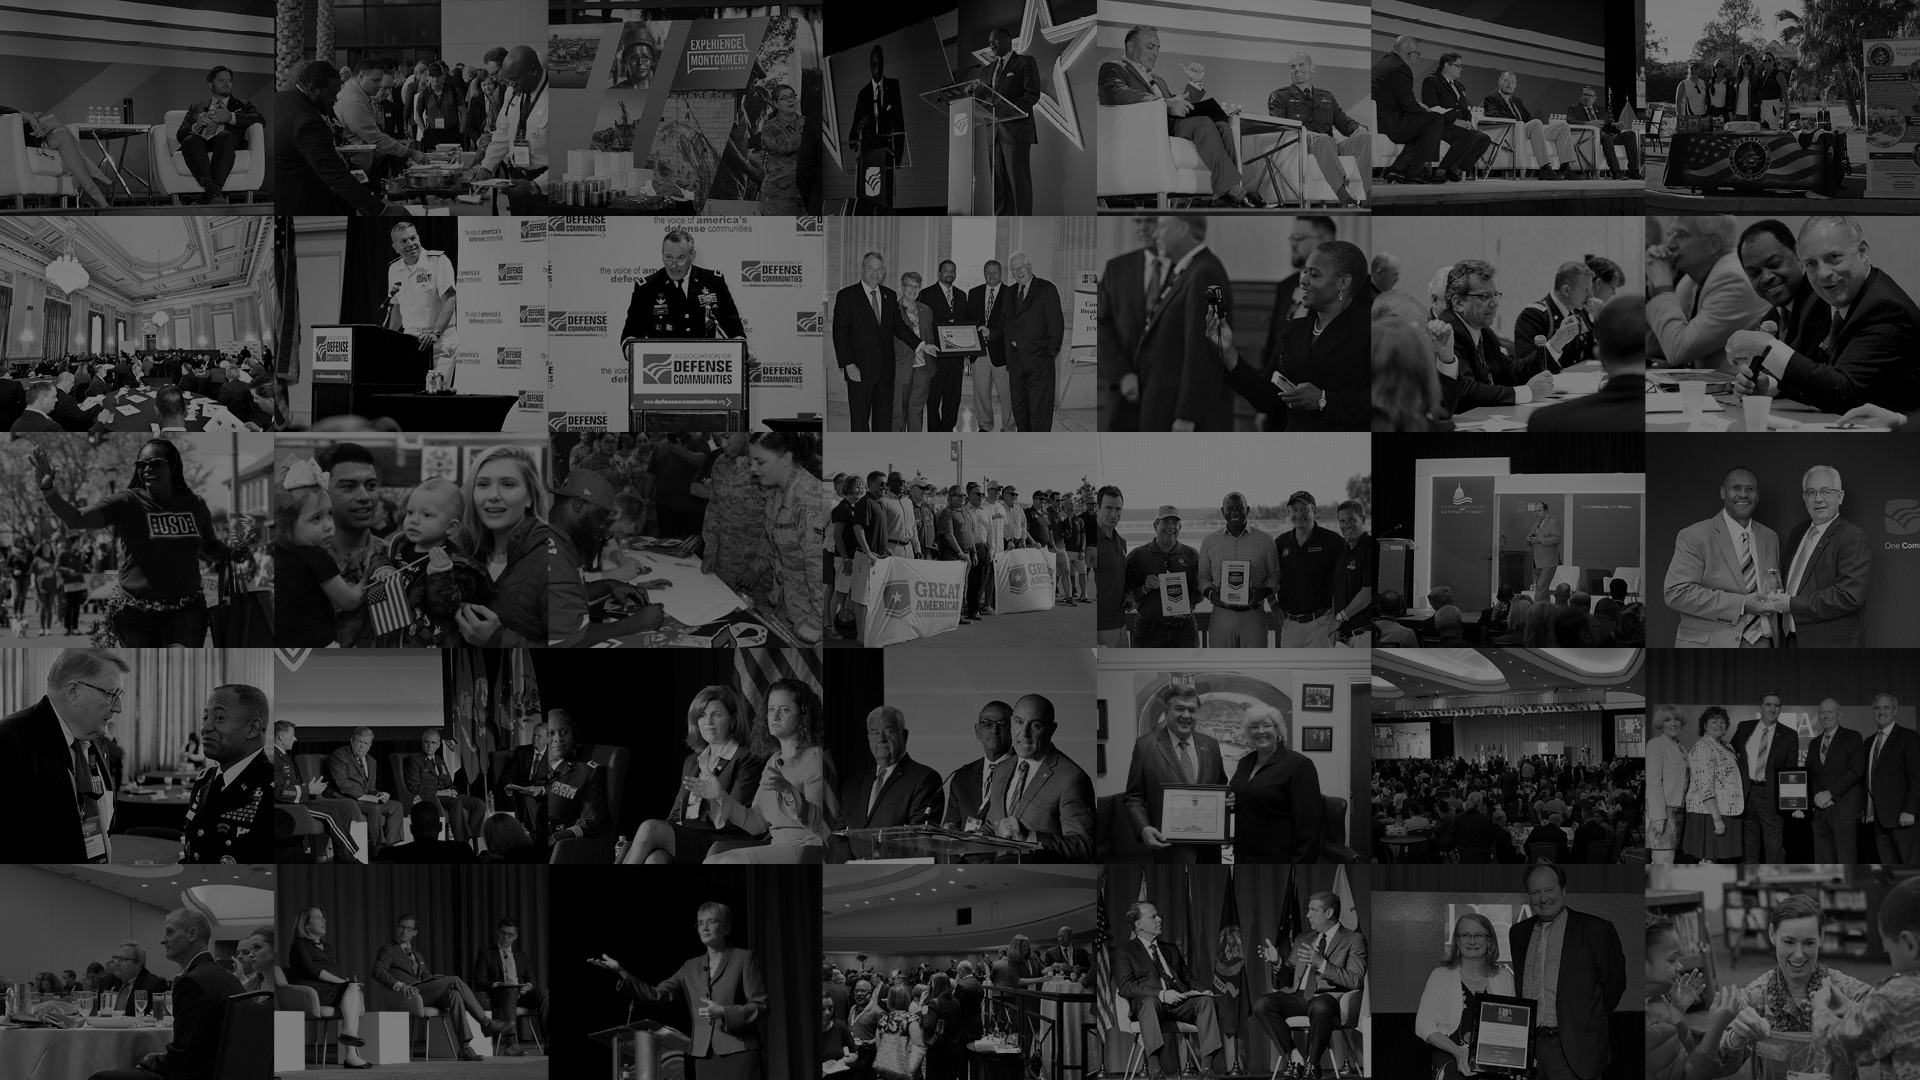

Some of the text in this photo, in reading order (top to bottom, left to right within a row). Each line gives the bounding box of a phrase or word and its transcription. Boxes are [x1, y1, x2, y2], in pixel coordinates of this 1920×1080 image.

[690, 38, 742, 50] EXPERIENCE
[691, 54, 749, 66] MONTGOMERY
[1732, 136, 1769, 151] OPERATION
[688, 216, 696, 224] of
[697, 216, 748, 224] america's
[529, 223, 547, 232] DEFENSE
[665, 225, 752, 233] defense communities
[506, 266, 523, 275] DEFENSE
[600, 266, 612, 275] the
[613, 266, 632, 275] voice
[633, 266, 642, 275] of
[762, 265, 803, 275] DEFENSE
[762, 275, 803, 283] COMMUNITIES
[528, 308, 546, 317] DEFENSE
[568, 315, 608, 325] DEFENSE
[327, 341, 349, 352] DEFENSE
[505, 350, 522, 359] DEFENSE
[673, 360, 733, 373] DEFENSE
[762, 366, 803, 375] DEFENSE
[673, 374, 733, 385] COMMUNITIES
[526, 394, 544, 402] DEFENSE
[568, 416, 608, 425] DEFENSE
[158, 516, 189, 534] USO
[1884, 542, 1900, 550] One
[914, 580, 961, 599] GREAT
[915, 600, 960, 611] AMERICAN
